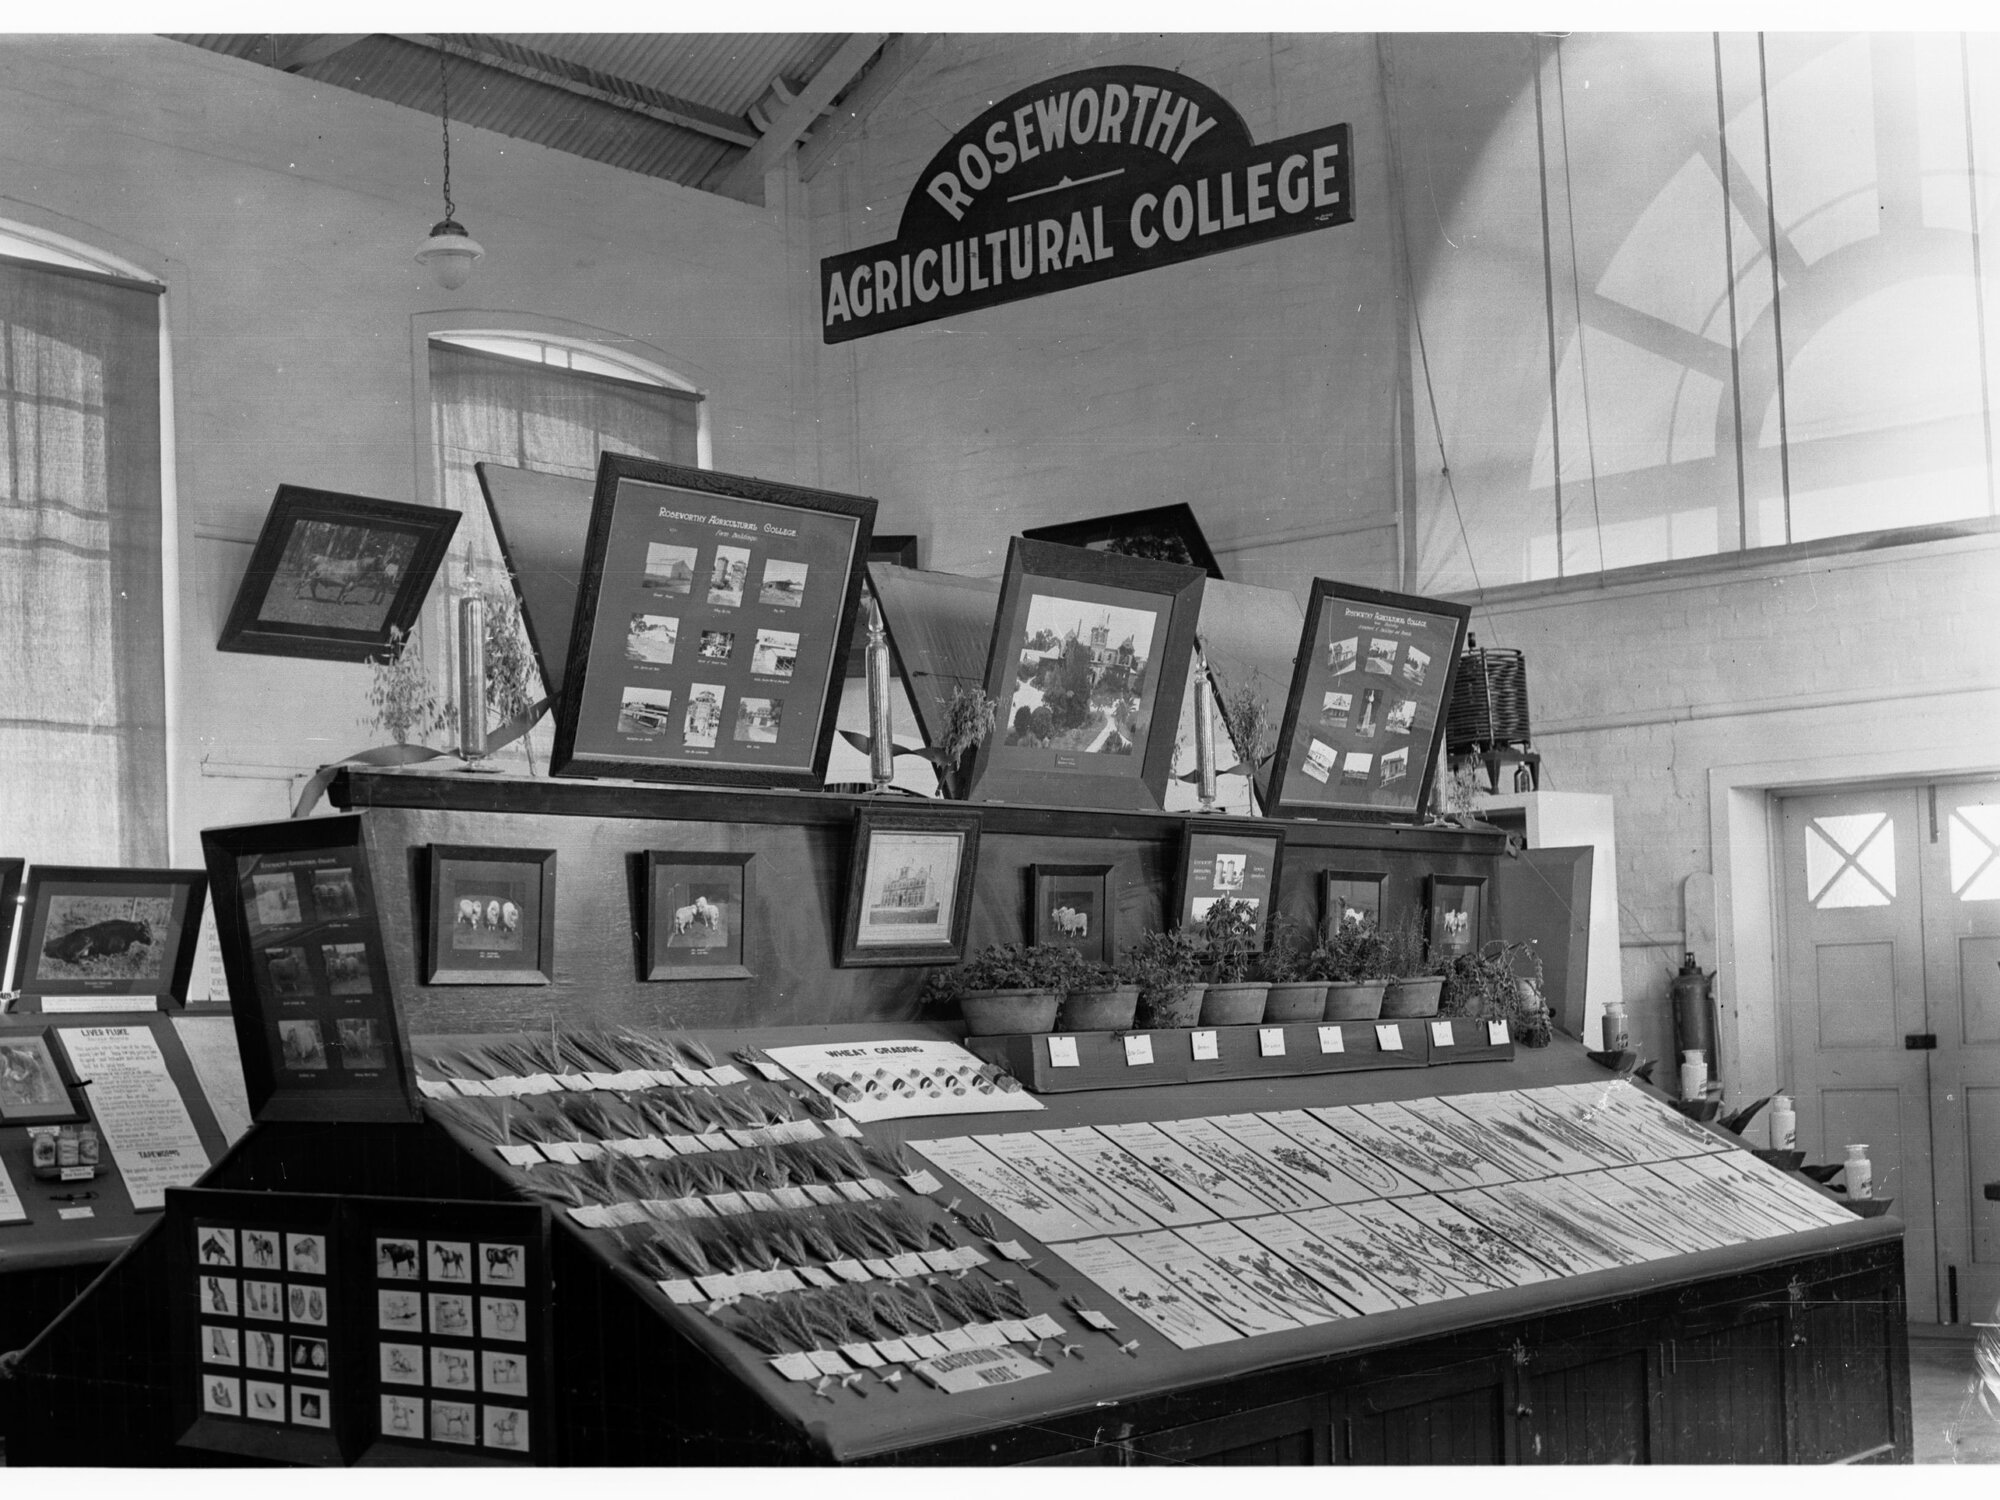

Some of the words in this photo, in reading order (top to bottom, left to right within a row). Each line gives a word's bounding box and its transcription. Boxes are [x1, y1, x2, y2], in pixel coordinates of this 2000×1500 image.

[926, 83, 1217, 221] ROSEWORTHY
[826, 205, 1114, 326] AGRICULTURAL
[1130, 144, 1340, 249] COLLEGE
[825, 1049, 867, 1057] WHEAT
[874, 1046, 924, 1054] GRADING
